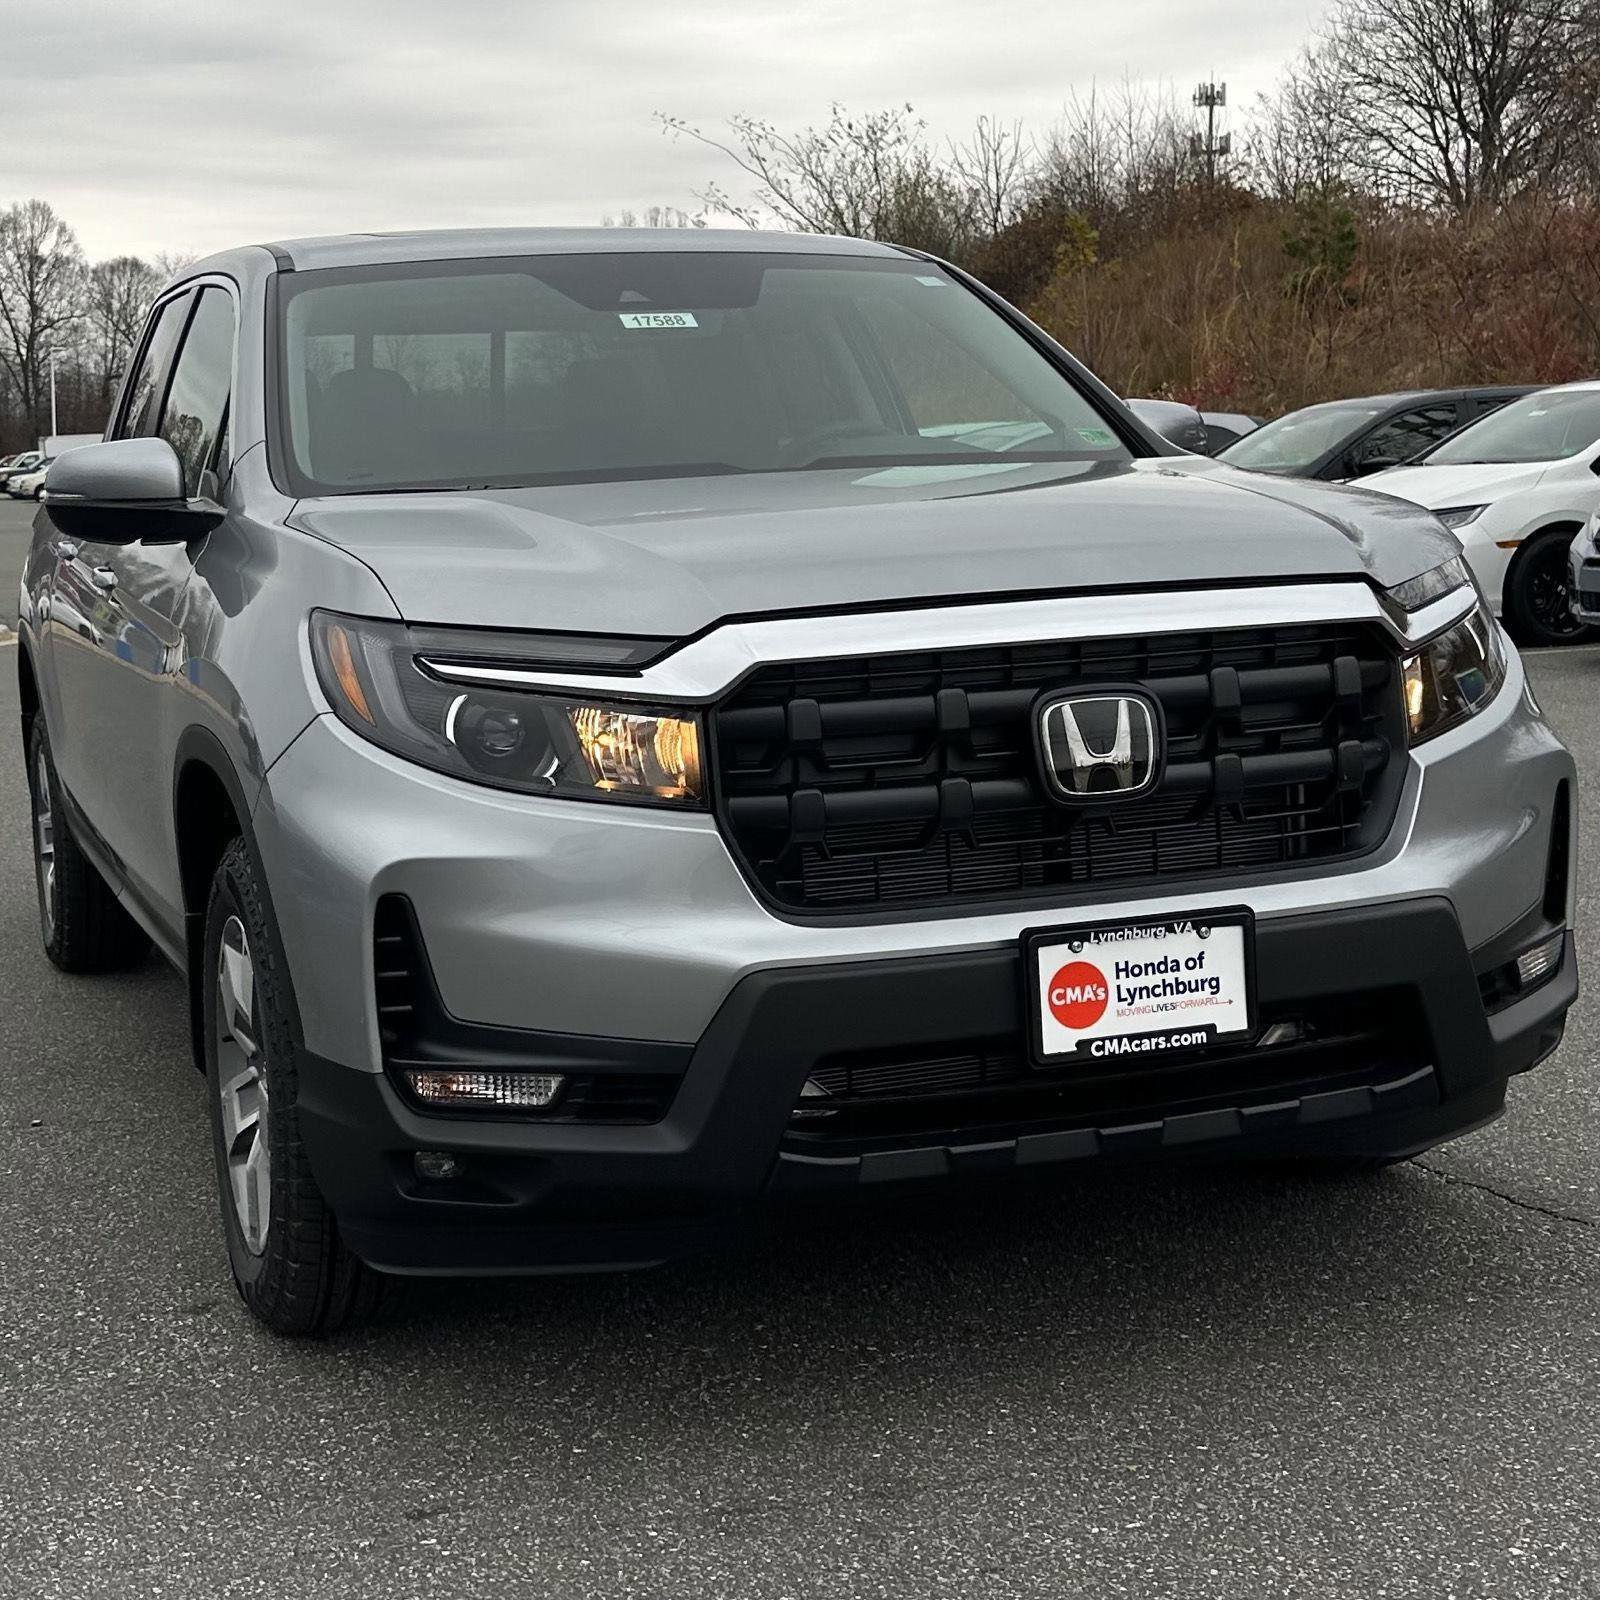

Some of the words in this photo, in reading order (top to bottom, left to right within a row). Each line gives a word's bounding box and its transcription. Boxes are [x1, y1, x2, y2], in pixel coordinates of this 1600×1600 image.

[632, 315, 686, 326] 17588
[1173, 921, 1193, 935] VA
[1115, 956, 1180, 979] Honda
[1184, 951, 1205, 970] of
[1051, 984, 1105, 1006] CMA's
[1116, 977, 1220, 1006] Lynchburg
[1091, 1031, 1207, 1057] CMAcars.com
